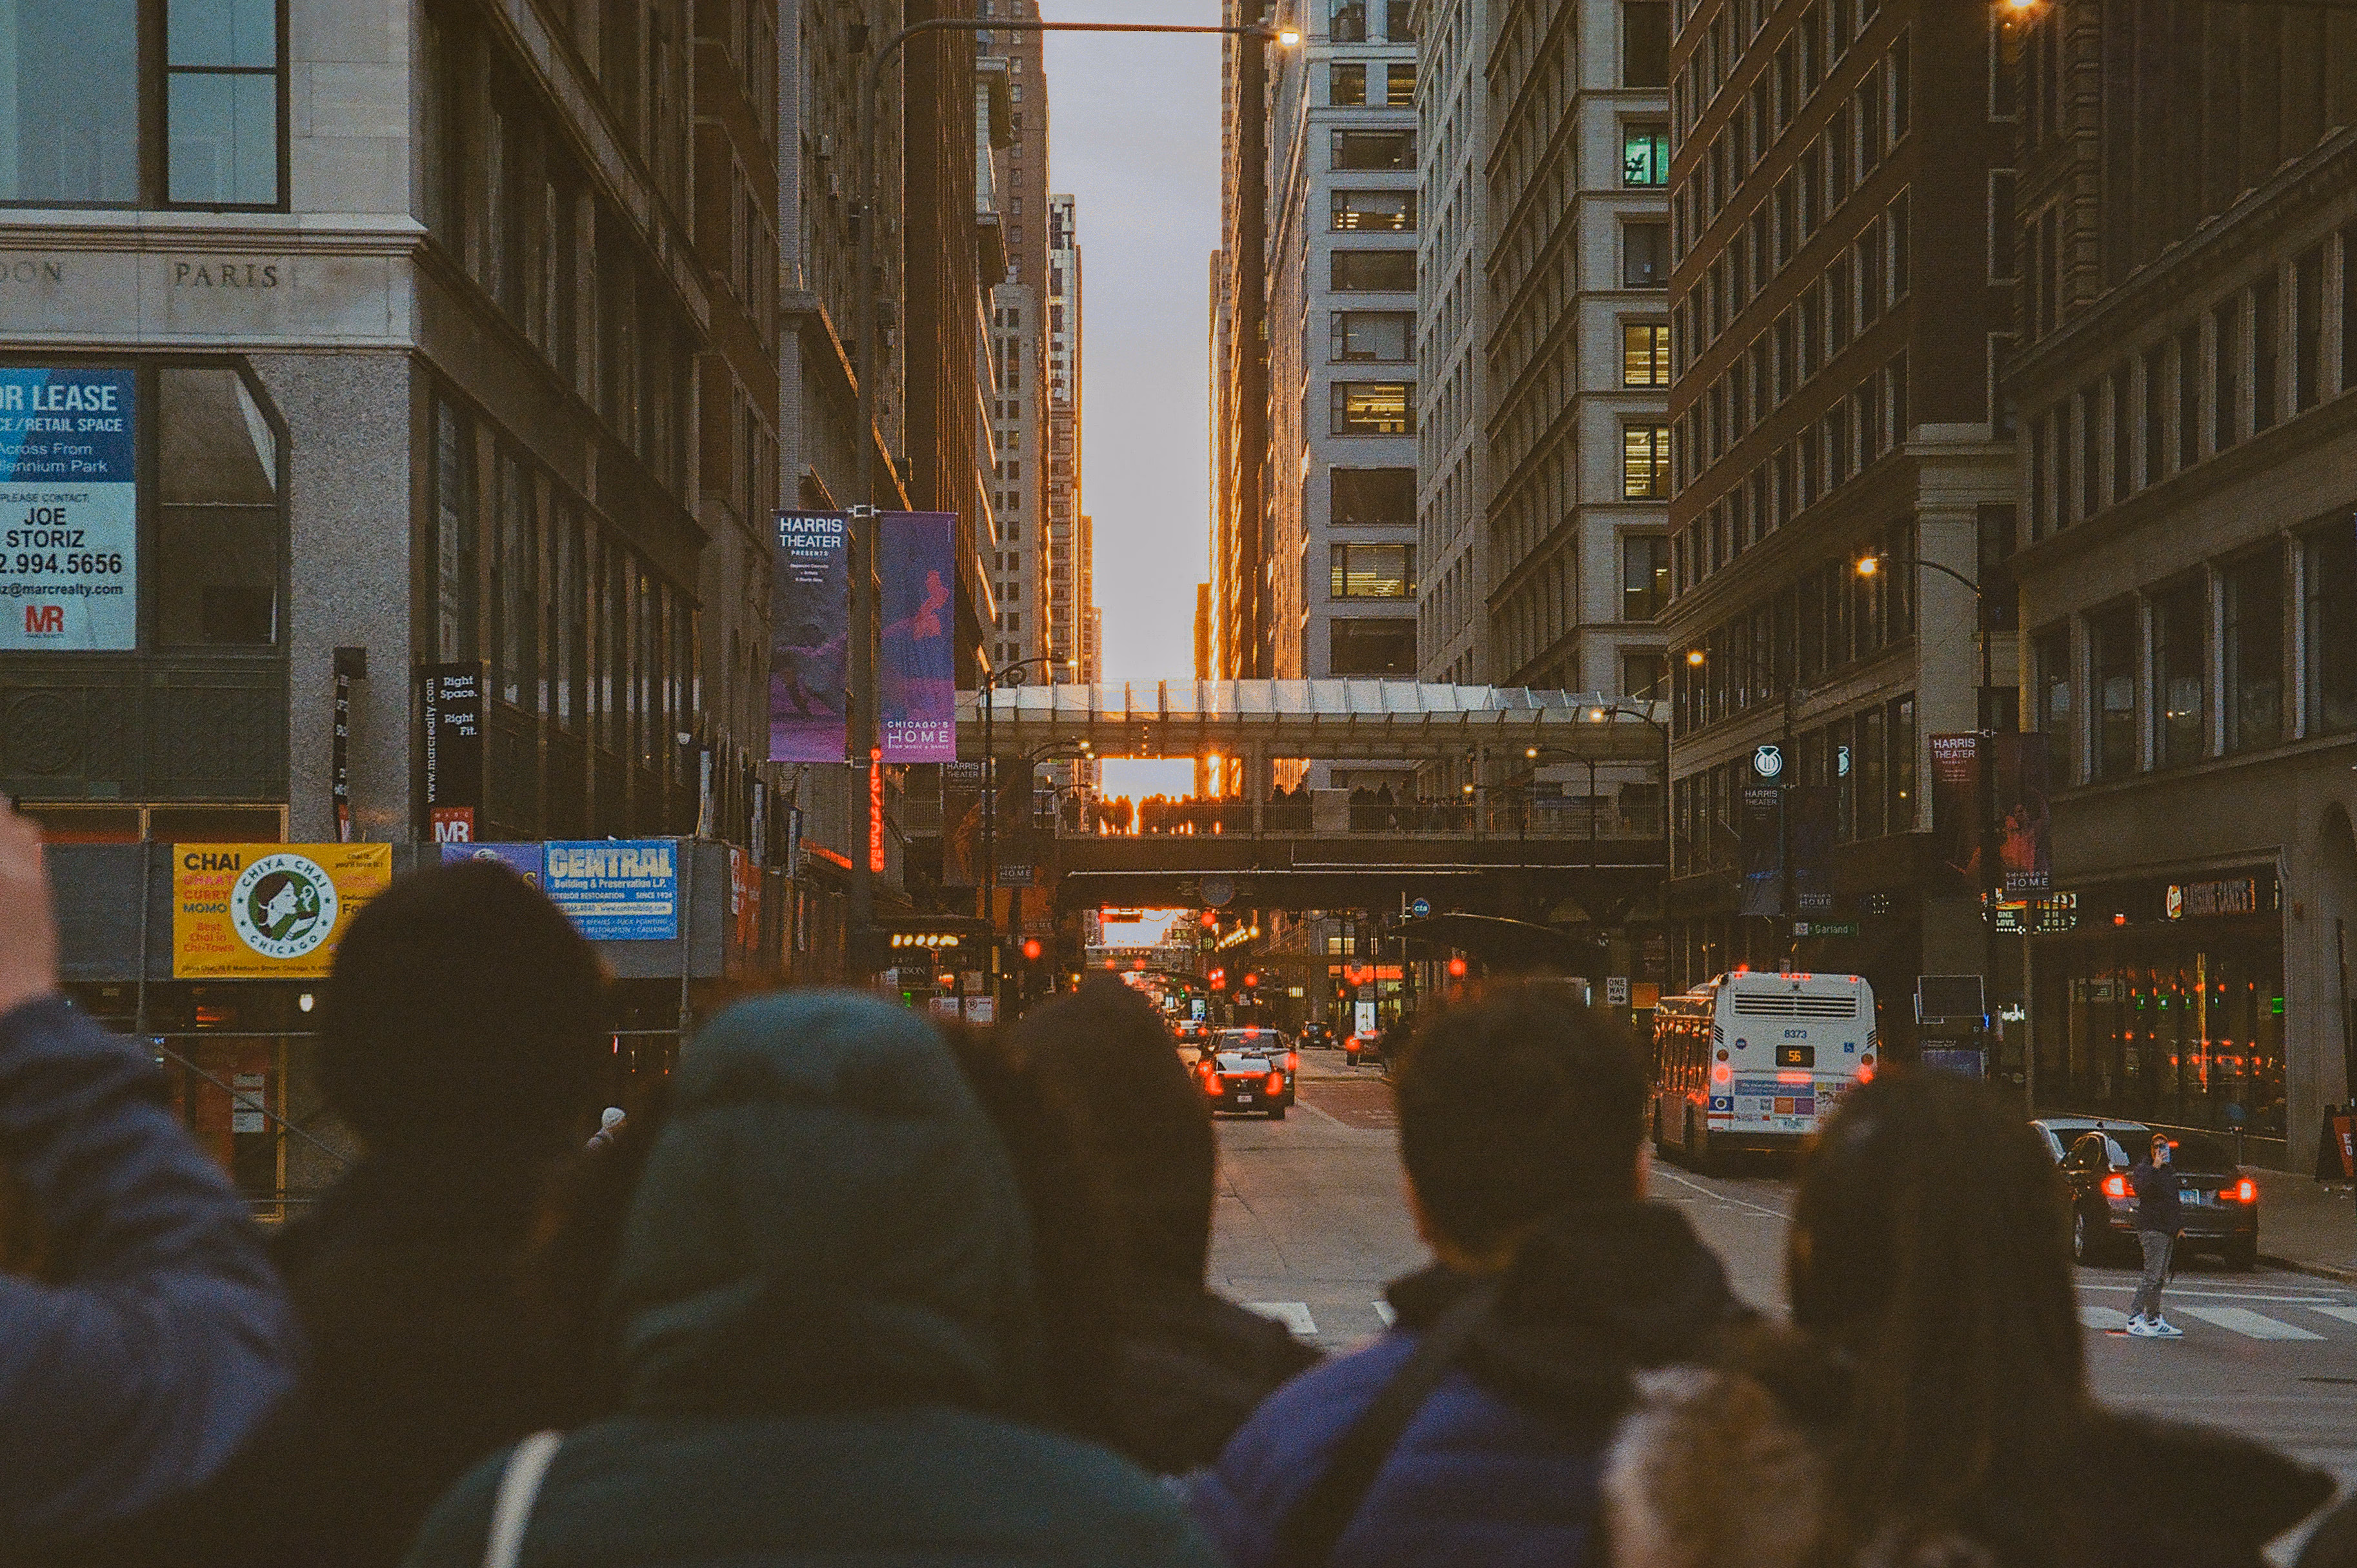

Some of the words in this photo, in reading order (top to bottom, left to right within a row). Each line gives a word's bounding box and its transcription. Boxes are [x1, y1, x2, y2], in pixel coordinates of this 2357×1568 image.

[174, 262, 279, 288] PARIS
[0, 385, 23, 411] R
[32, 385, 118, 411] LEASE
[77, 417, 123, 432] SPACE
[53, 442, 93, 455] From
[70, 459, 108, 473] Park
[23, 507, 66, 526] JOE
[779, 518, 843, 533] HARRIS
[6, 529, 85, 548] STORIZ
[779, 534, 841, 548] THEATER
[0, 583, 124, 598] z@marcrealty.com
[25, 605, 65, 633] MR
[443, 676, 474, 689] Right
[439, 689, 478, 701] Space.
[444, 712, 474, 725] Right
[887, 720, 949, 729] CHICAGO'S
[459, 725, 478, 736] Fit.
[425, 678, 437, 804] www.marcrealty.com
[888, 729, 949, 749] HOME
[1933, 738, 1976, 749] HARRIS
[1934, 749, 1976, 759] THEATER
[947, 761, 979, 771] HARRIS
[1745, 789, 1778, 798] HARRIS
[434, 821, 470, 842] MR
[183, 852, 241, 871] CHAI
[548, 847, 673, 878] CENTRAL
[183, 874, 234, 886] CHAAT
[241, 858, 285, 888] CHIYA
[294, 859, 328, 889] CHAI
[999, 869, 1032, 879] HOME
[554, 879, 588, 890] Building
[590, 879, 597, 889] &
[598, 878, 651, 889] Preservation
[652, 878, 667, 889] L.P.
[2006, 878, 2049, 891] HOME
[183, 889, 229, 901] CURRY
[183, 903, 228, 914] MOMO
[1799, 898, 1831, 908] HOME
[1814, 924, 1849, 934] Garland
[250, 934, 319, 955] CHICAGO
[1784, 1029, 1807, 1040] 8373
[1788, 1050, 1801, 1062] 56
